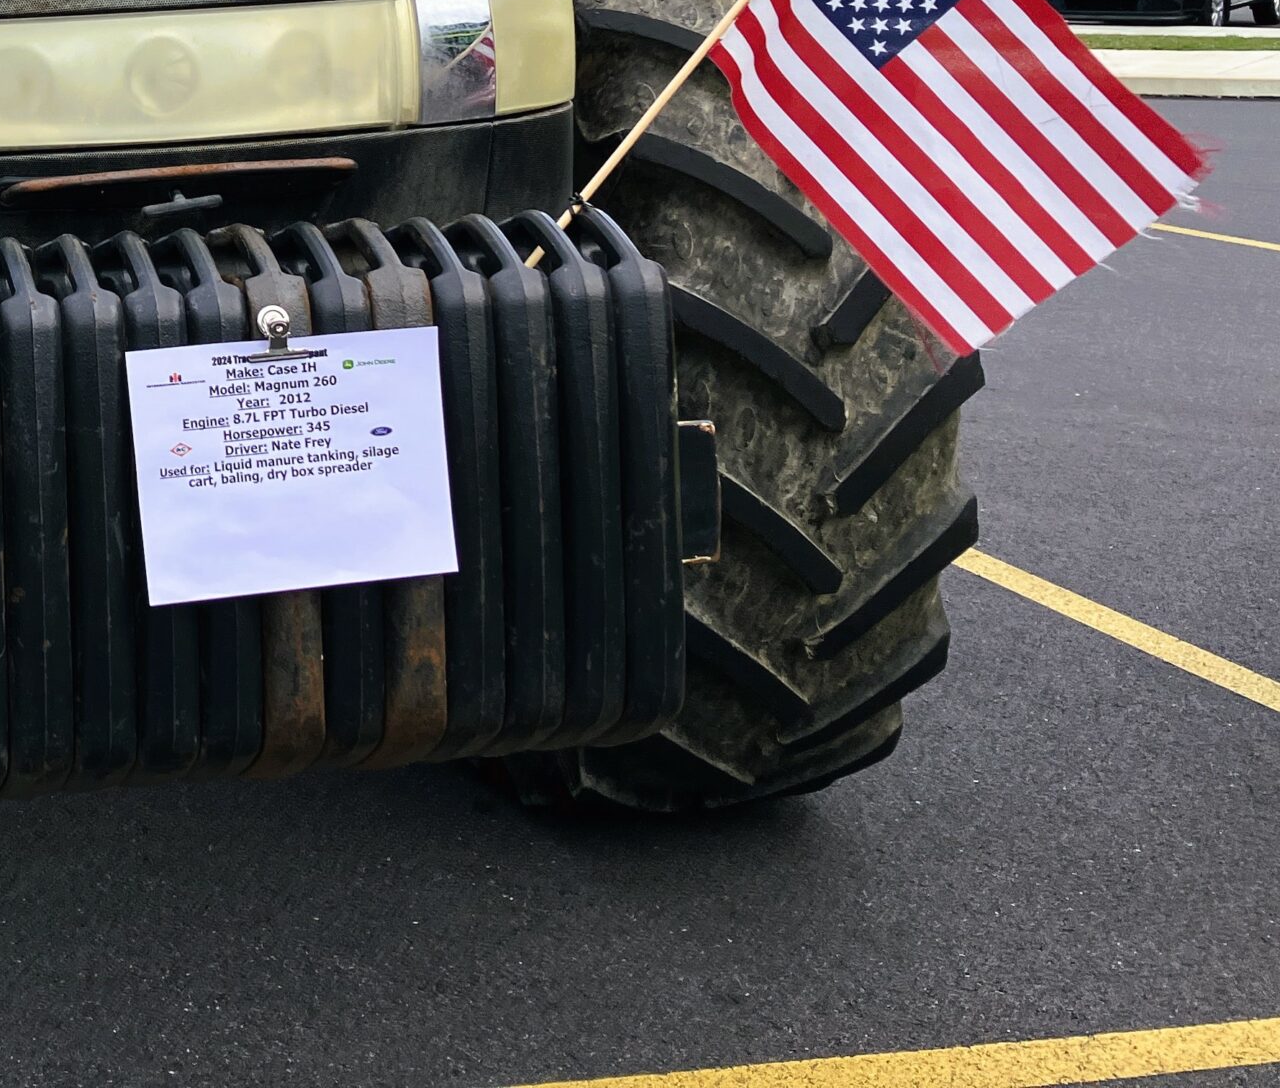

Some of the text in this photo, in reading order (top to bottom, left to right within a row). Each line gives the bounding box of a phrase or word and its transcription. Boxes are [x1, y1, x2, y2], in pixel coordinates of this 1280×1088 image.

[211, 355, 232, 366] 2024
[226, 362, 317, 381] Make: Case IH
[209, 383, 252, 398] Model:
[254, 378, 309, 393] Magnum
[313, 375, 337, 387] 260
[237, 392, 311, 410] Year: 2012
[182, 402, 369, 431] Engine: 8.7L FPT Turbo Diesel
[223, 420, 331, 442] Horsepower: 345
[224, 437, 332, 458] Driver: Nate Frey
[159, 446, 400, 479] Used for: Liquid manure tanking, silage
[188, 460, 373, 488] cart, baling, dry box spreader
